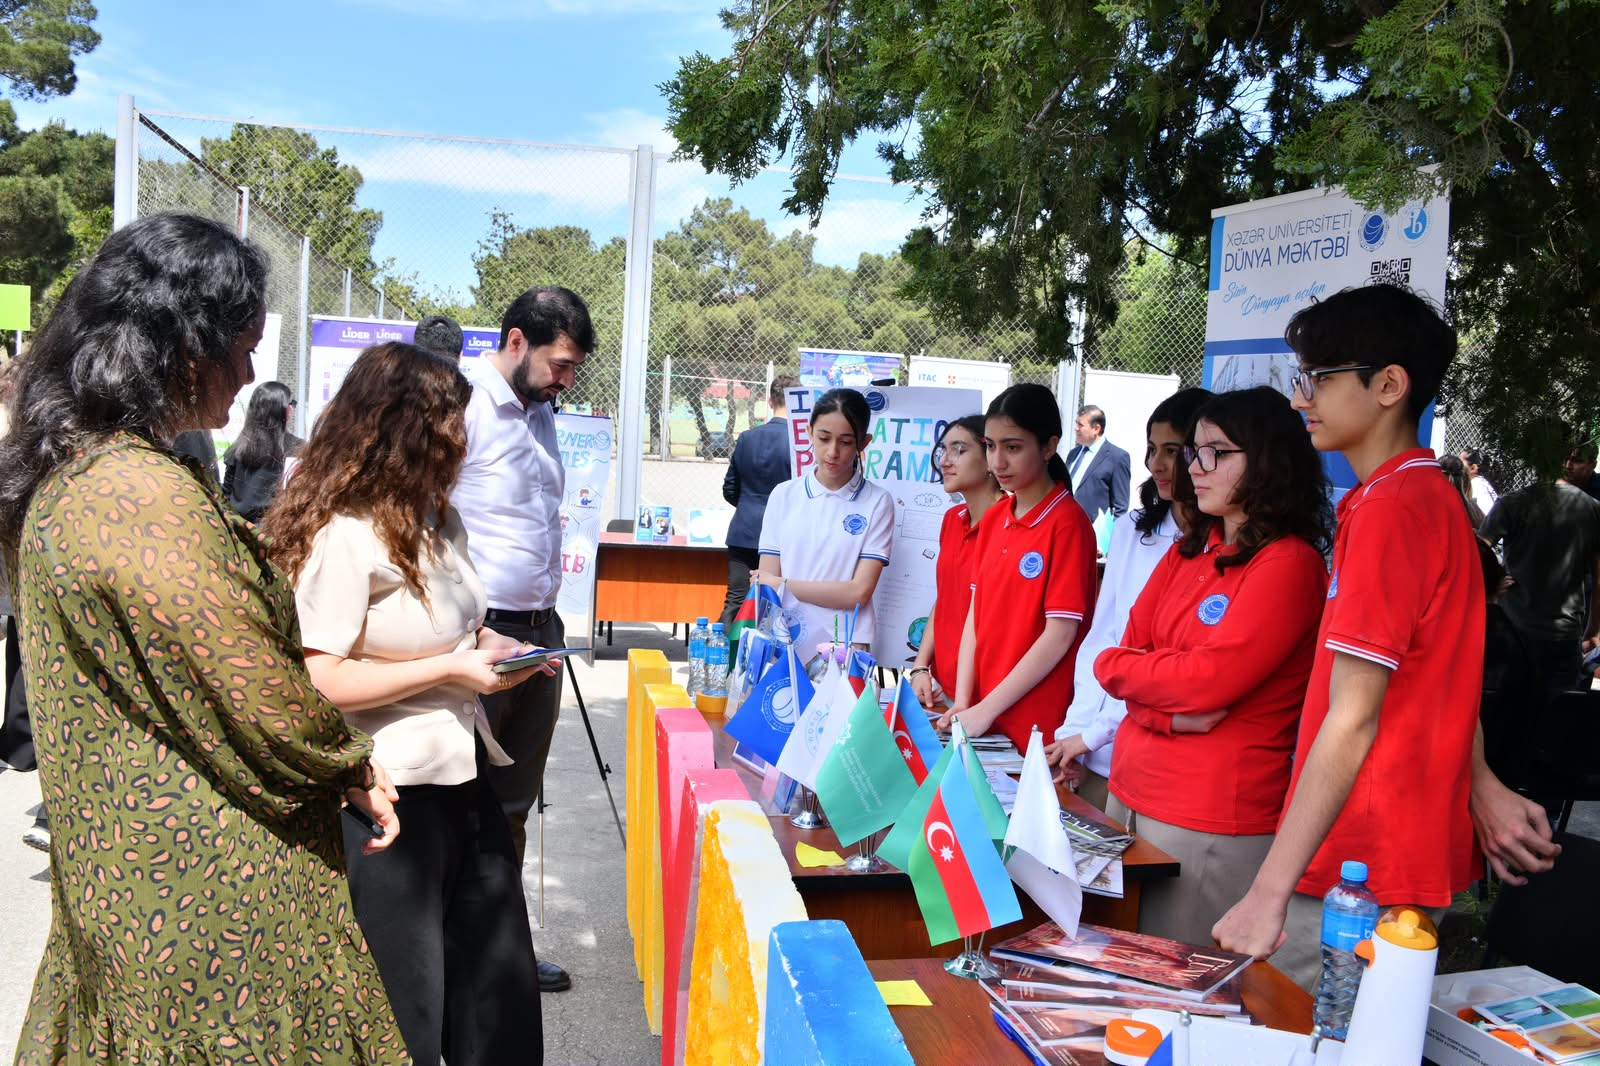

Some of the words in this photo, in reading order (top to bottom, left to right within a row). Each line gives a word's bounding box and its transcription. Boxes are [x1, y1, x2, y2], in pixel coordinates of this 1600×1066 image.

[1227, 227, 1265, 247] XƏZƏR
[1268, 209, 1353, 241] UNİVERSİTETİ
[1224, 247, 1272, 273] DÜNYA
[1277, 231, 1351, 265] MƏKTƏBİ
[468, 335, 493, 348] LİDER
[918, 373, 937, 382] ITAC
